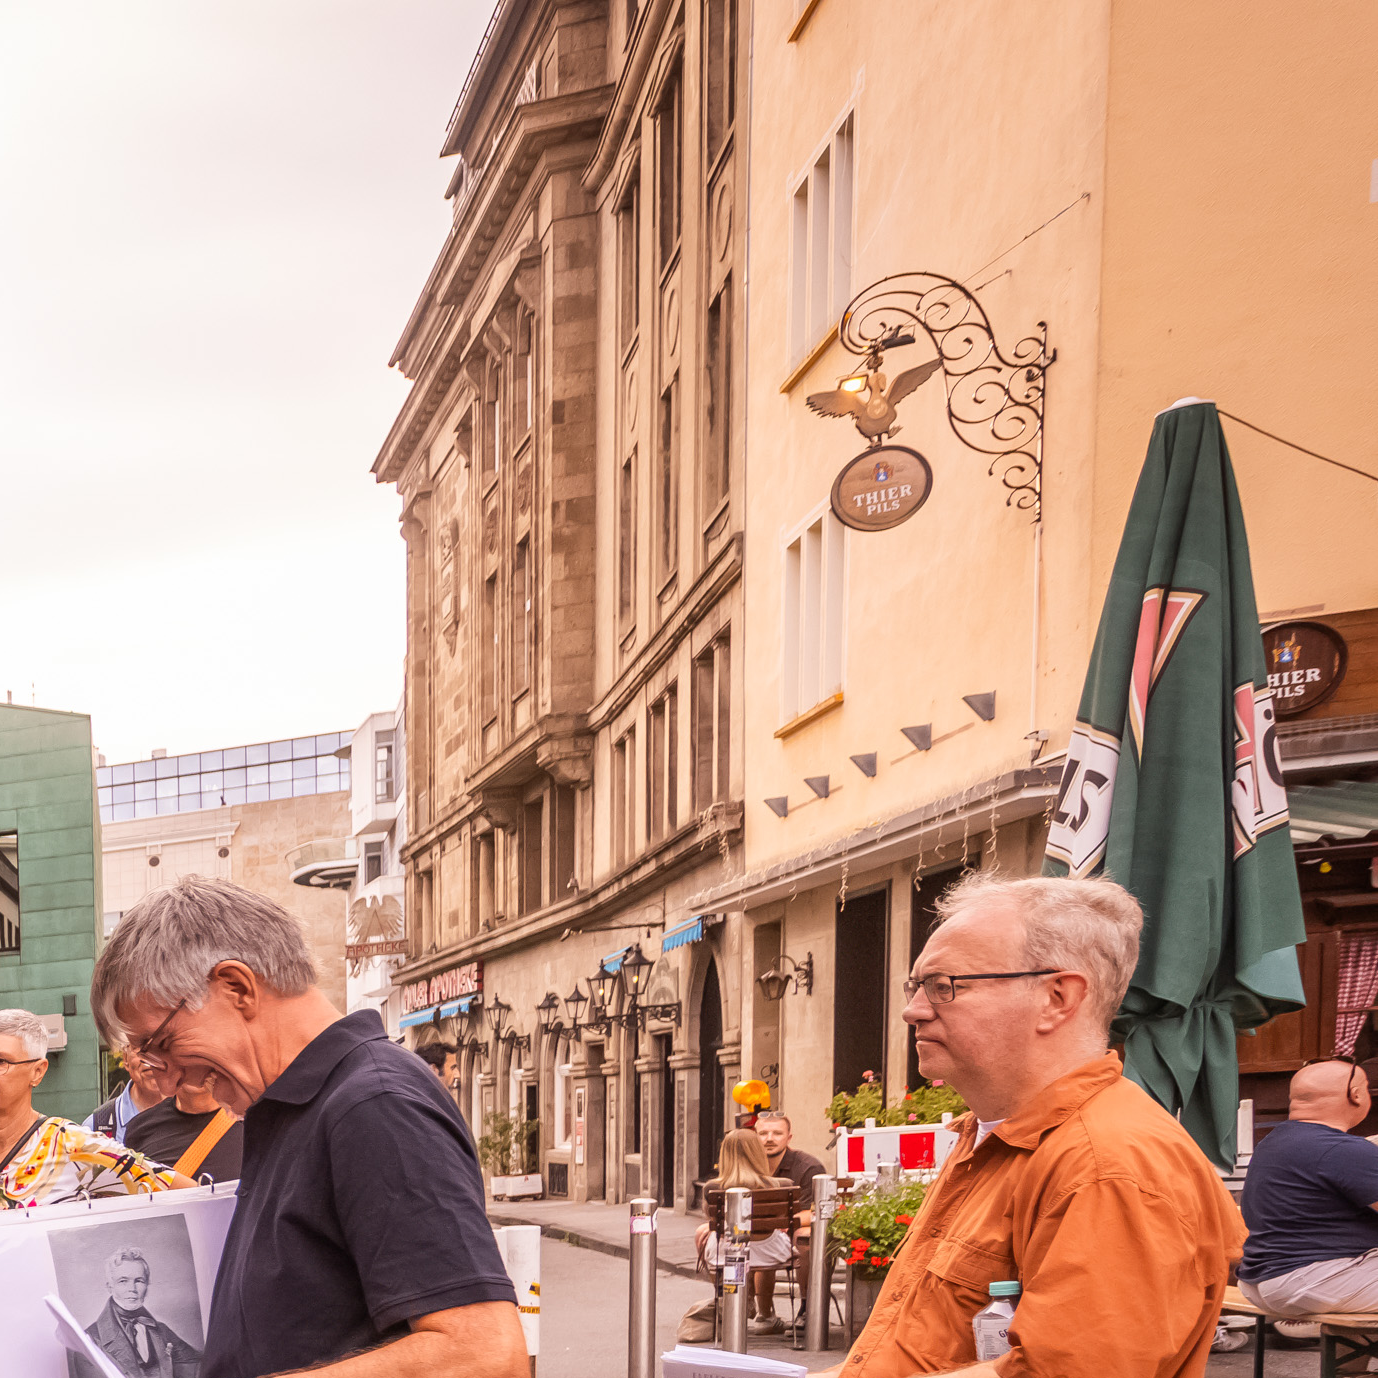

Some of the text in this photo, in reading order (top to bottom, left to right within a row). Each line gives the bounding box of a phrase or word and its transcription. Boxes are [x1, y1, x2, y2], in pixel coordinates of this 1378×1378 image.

[853, 484, 912, 507] THIER
[867, 500, 900, 516] PILS
[1267, 668, 1322, 687] HIER
[346, 941, 405, 956] APOTHEKE
[430, 962, 478, 1004] APOTHEKE
